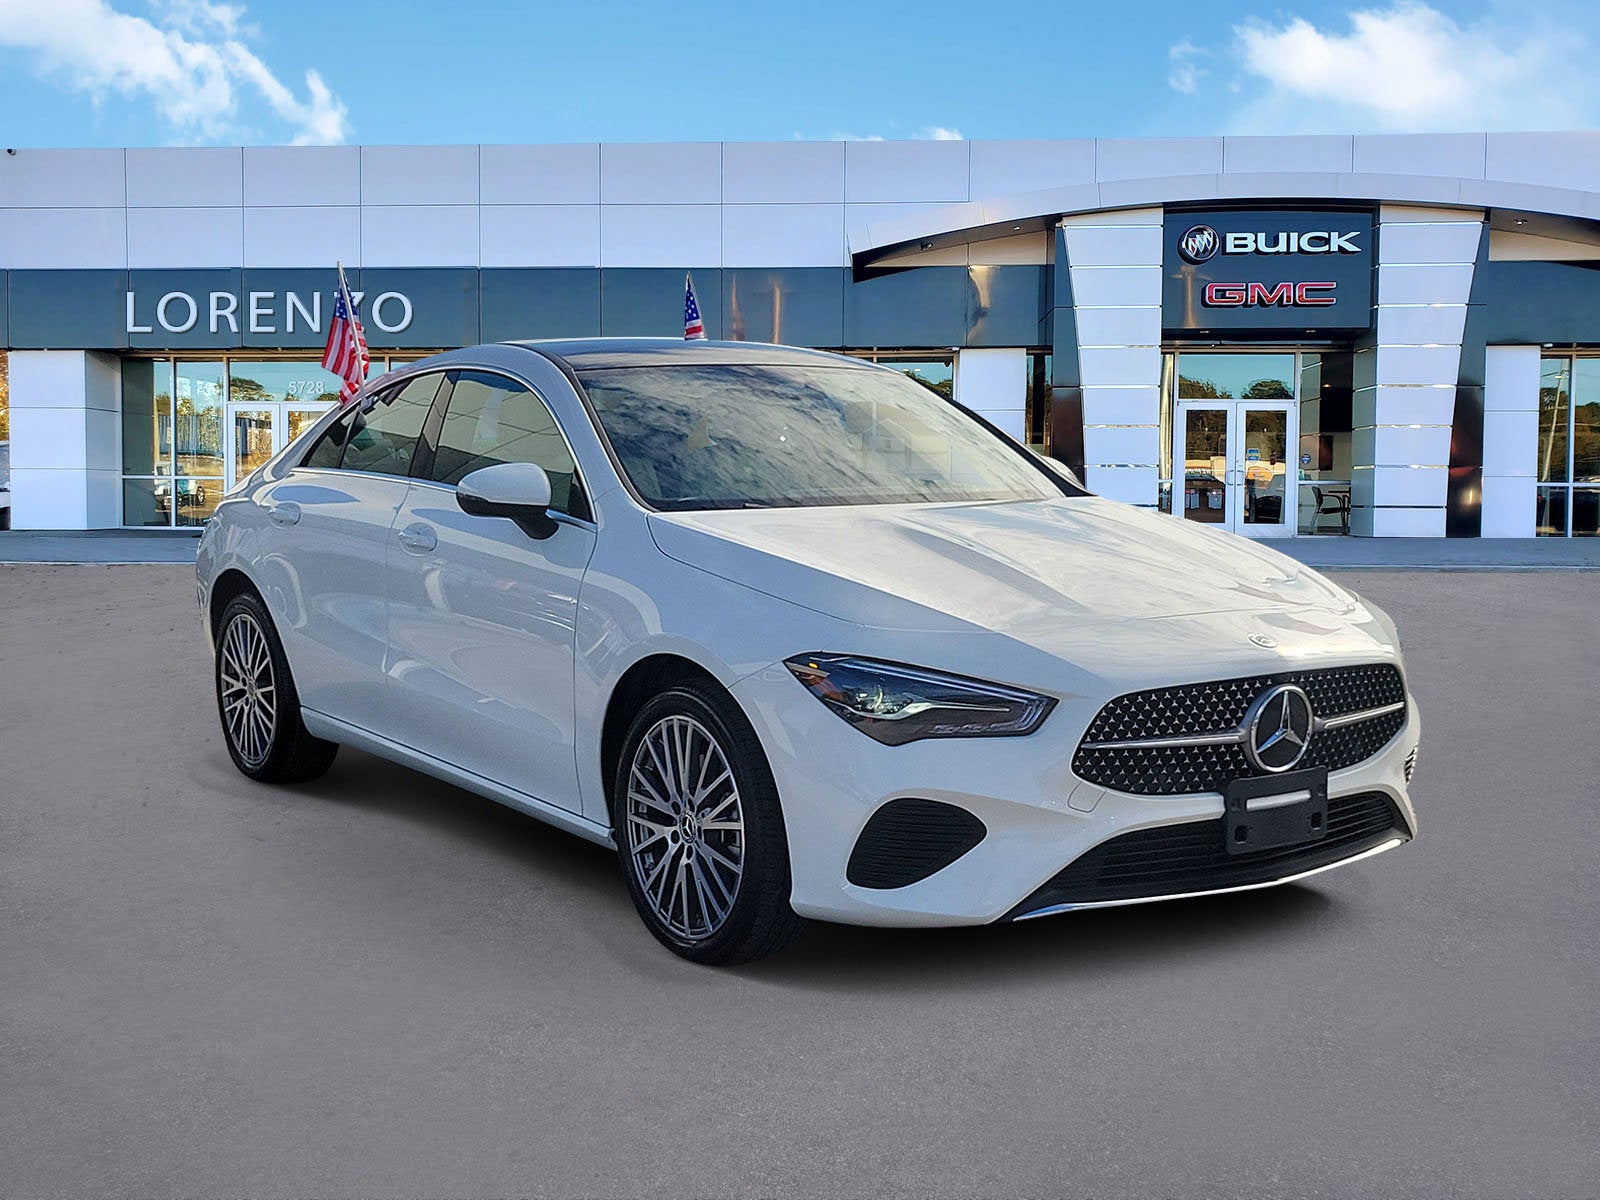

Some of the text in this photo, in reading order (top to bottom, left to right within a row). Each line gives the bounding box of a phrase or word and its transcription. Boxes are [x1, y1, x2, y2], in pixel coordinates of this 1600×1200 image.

[1226, 231, 1362, 253] BUICK
[1205, 282, 1337, 305] GMC
[288, 380, 325, 394] 5728
